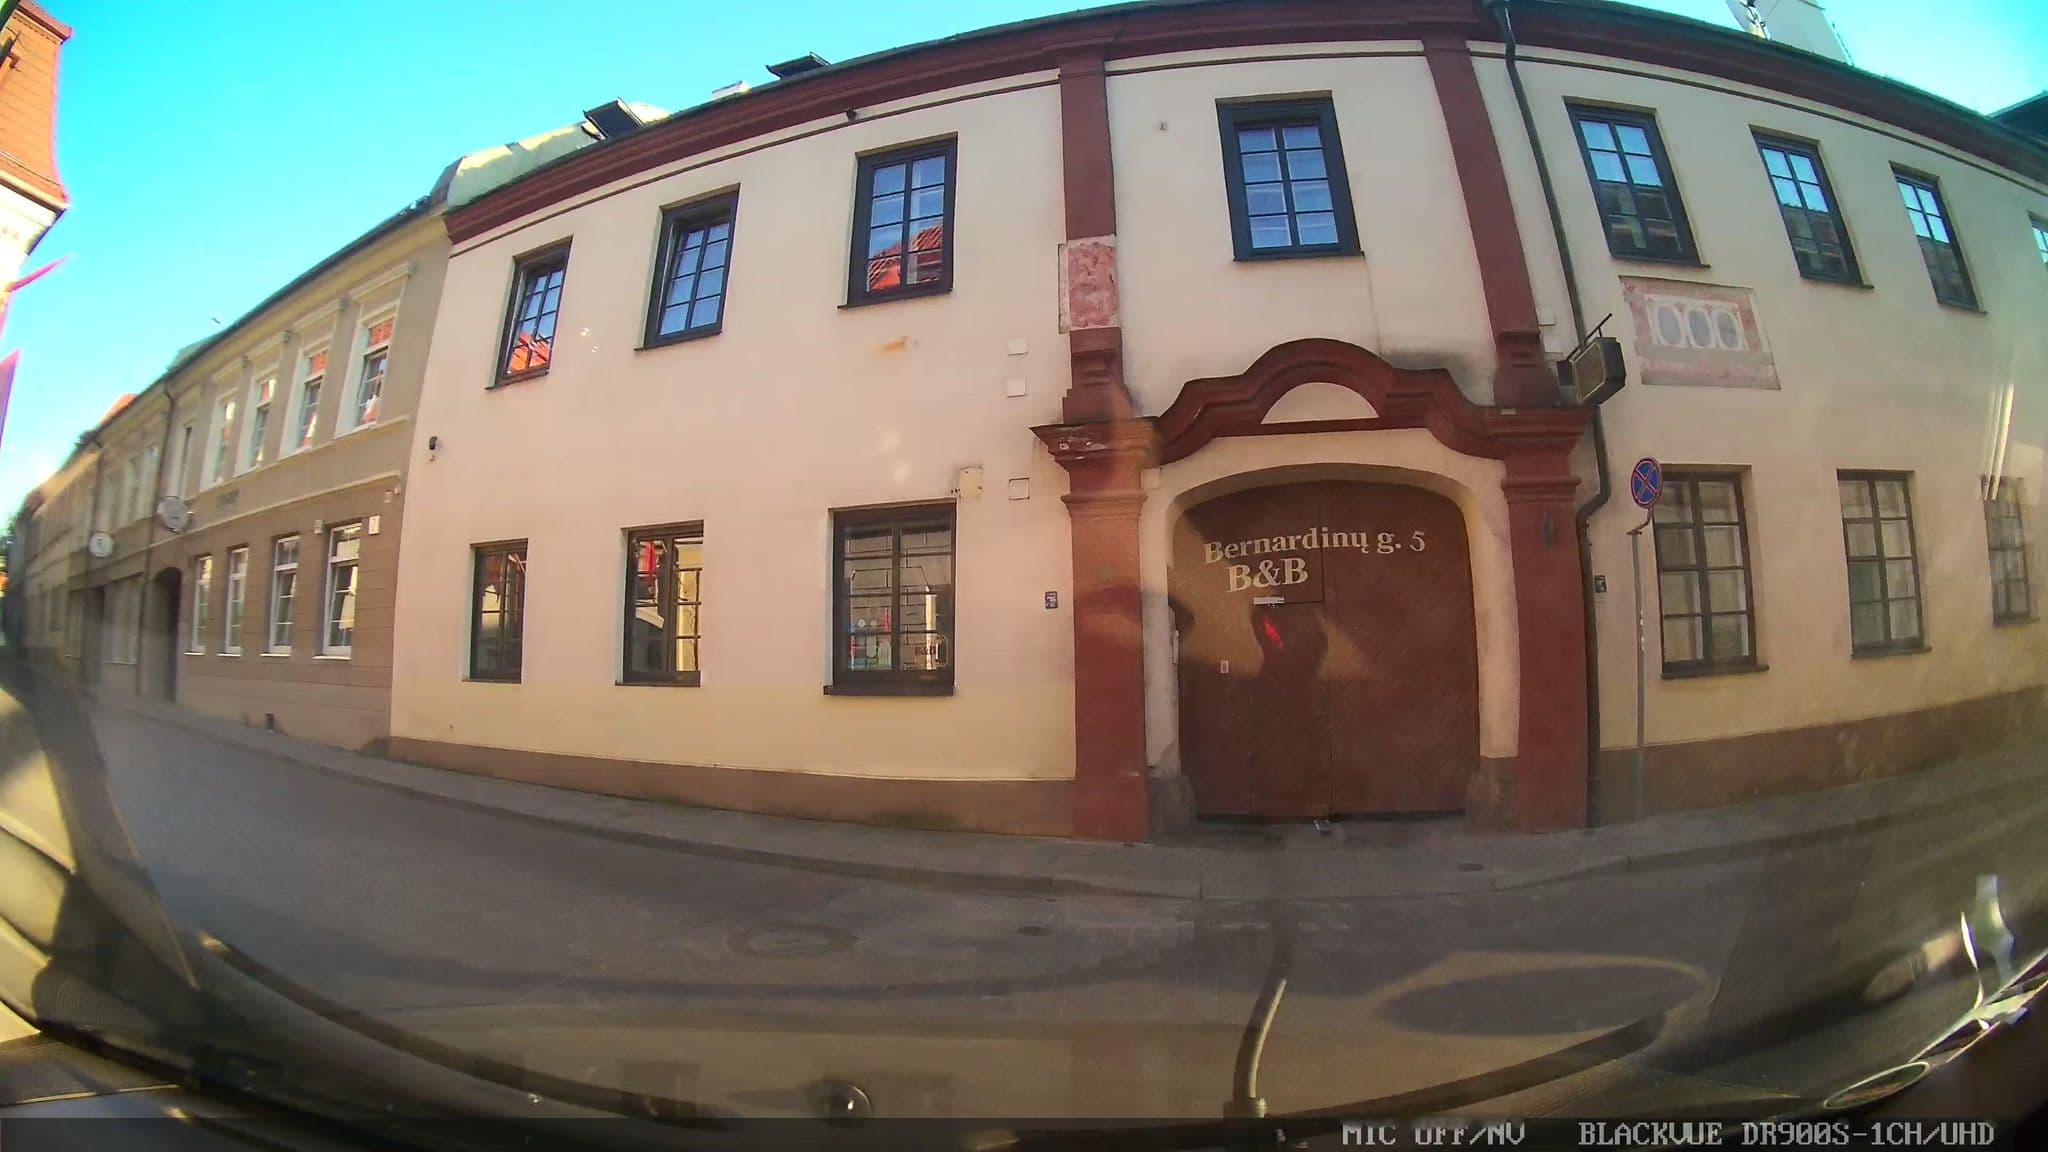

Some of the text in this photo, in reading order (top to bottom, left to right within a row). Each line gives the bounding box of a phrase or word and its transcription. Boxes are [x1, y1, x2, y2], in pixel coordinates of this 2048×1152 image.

[1203, 526, 1426, 565] Bernardinų g. 5
[1227, 557, 1309, 593] B&B
